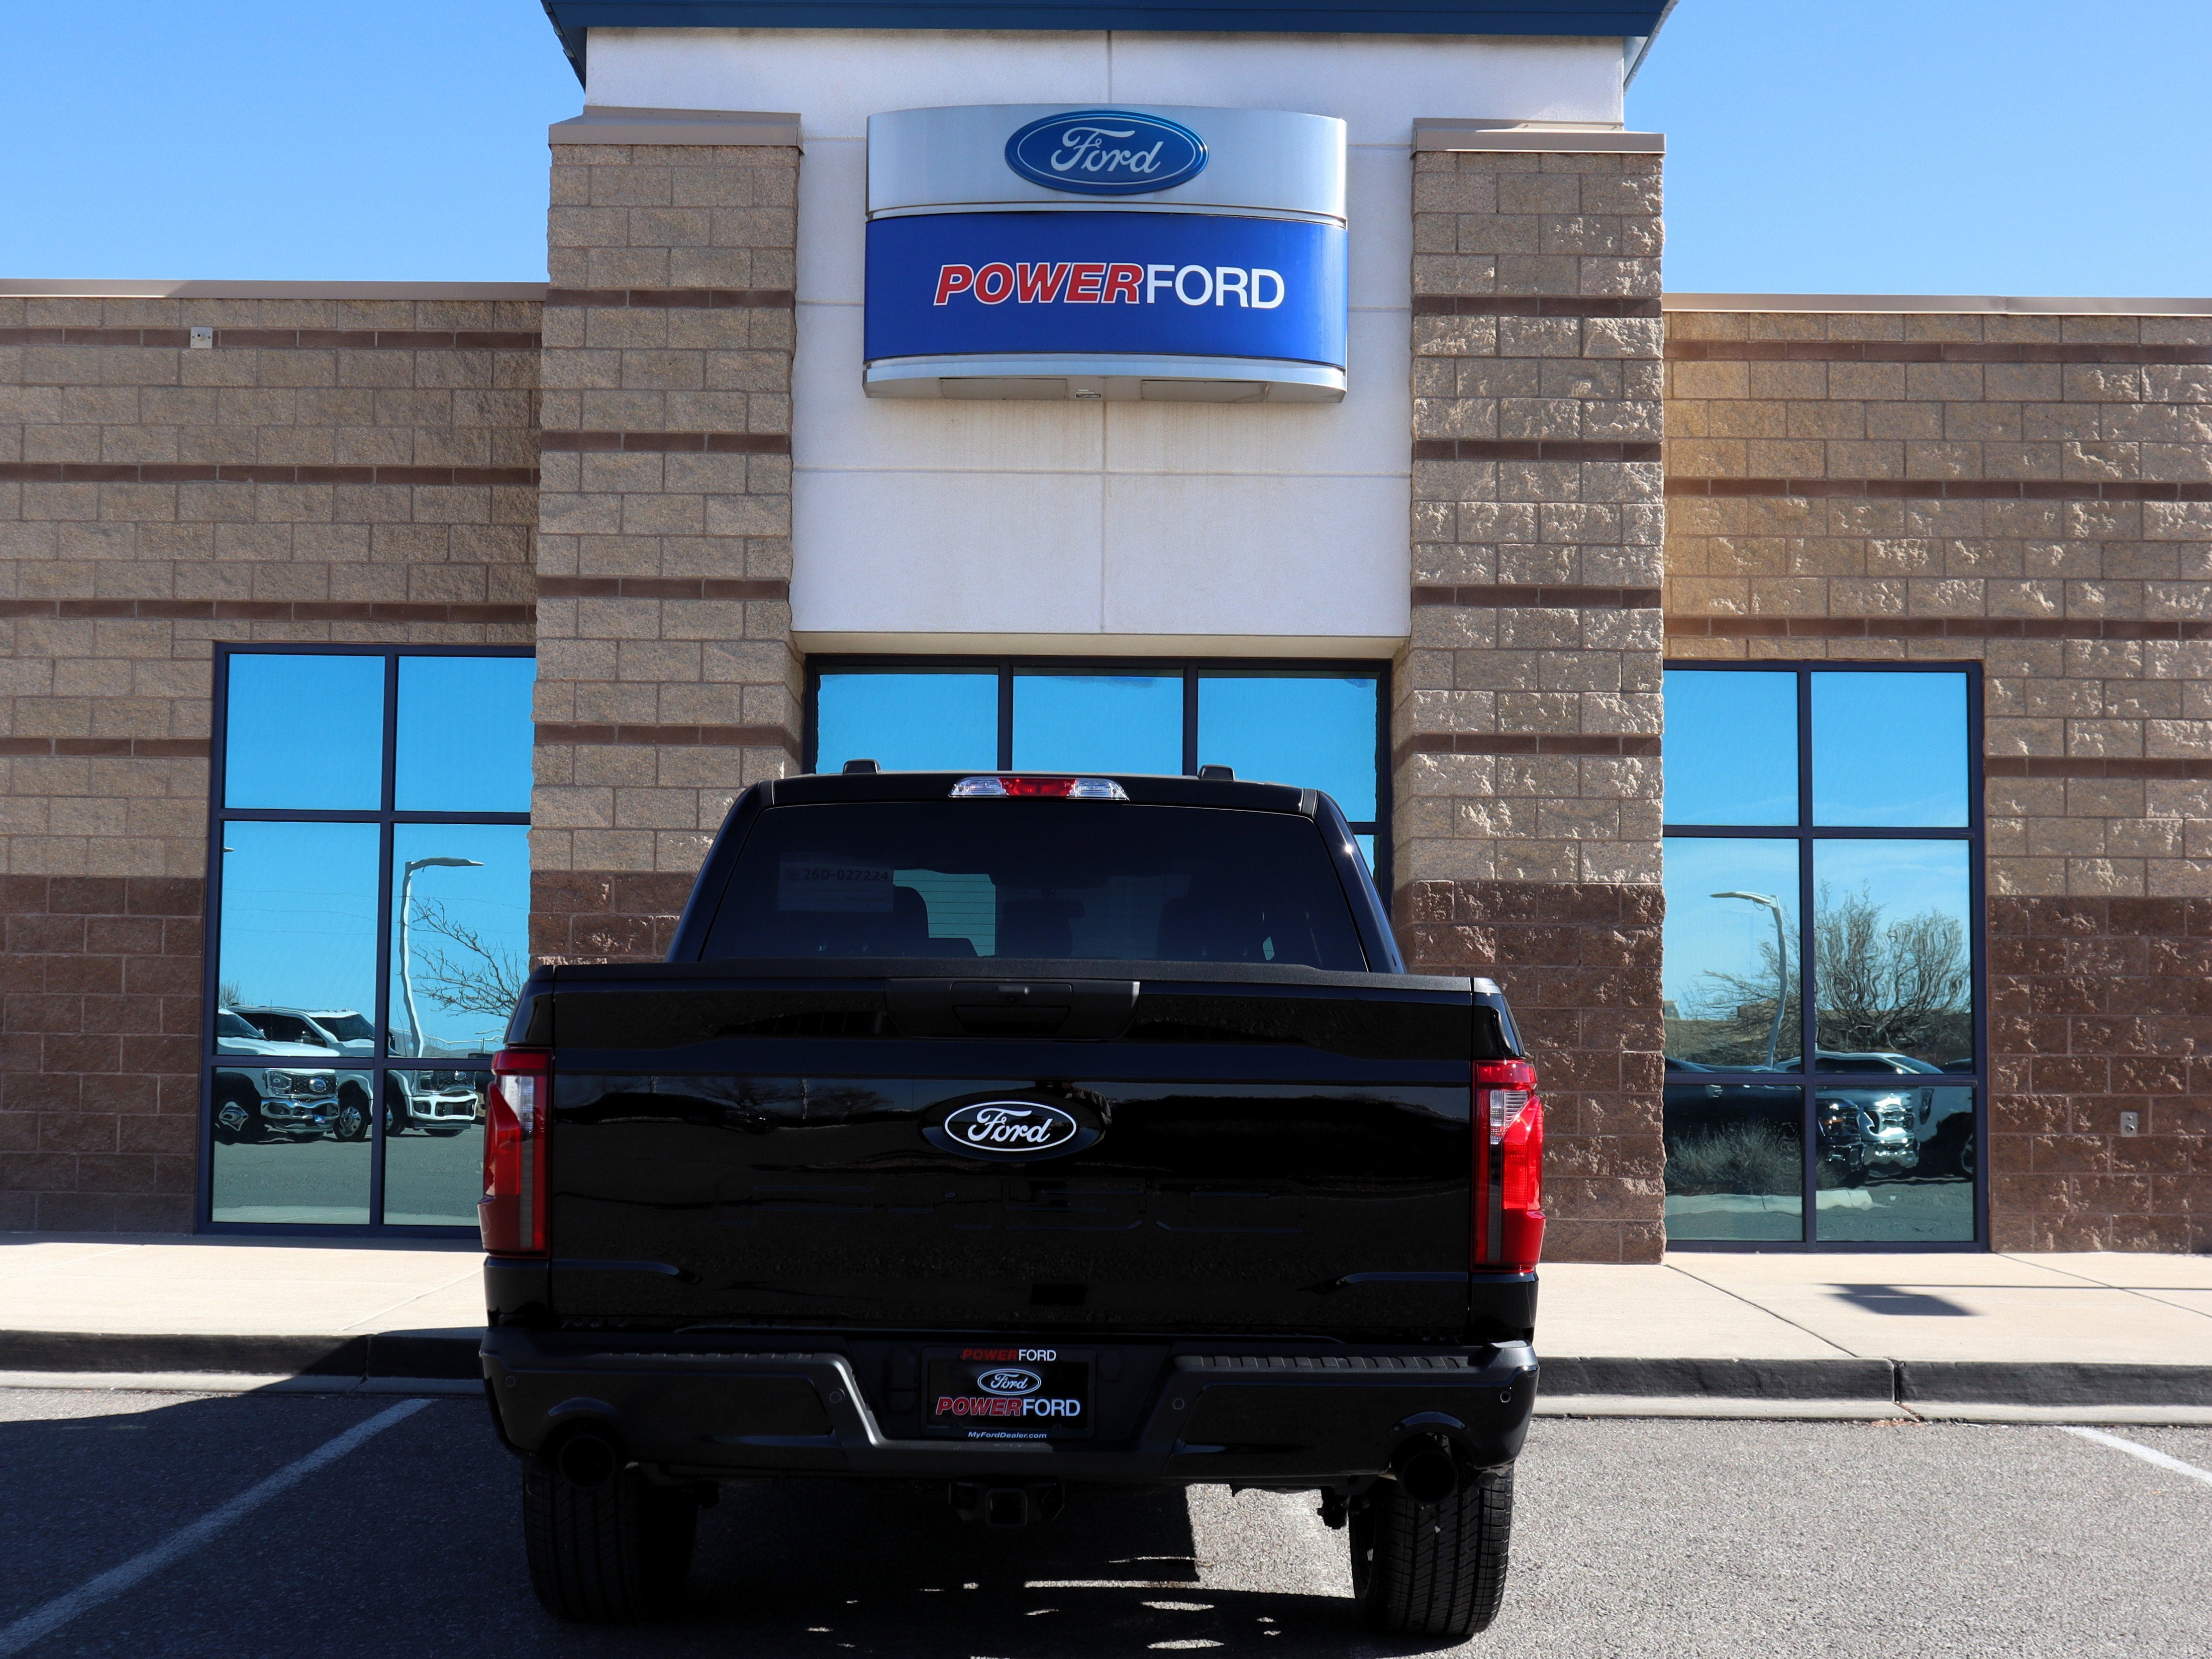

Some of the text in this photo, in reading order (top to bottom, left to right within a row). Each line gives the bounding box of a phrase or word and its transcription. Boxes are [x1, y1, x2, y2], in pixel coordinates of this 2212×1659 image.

[1050, 126, 1164, 174] Ford
[803, 869, 888, 881] 26D-027224
[967, 1107, 1053, 1143] Ford
[990, 1373, 1028, 1389] Ford
